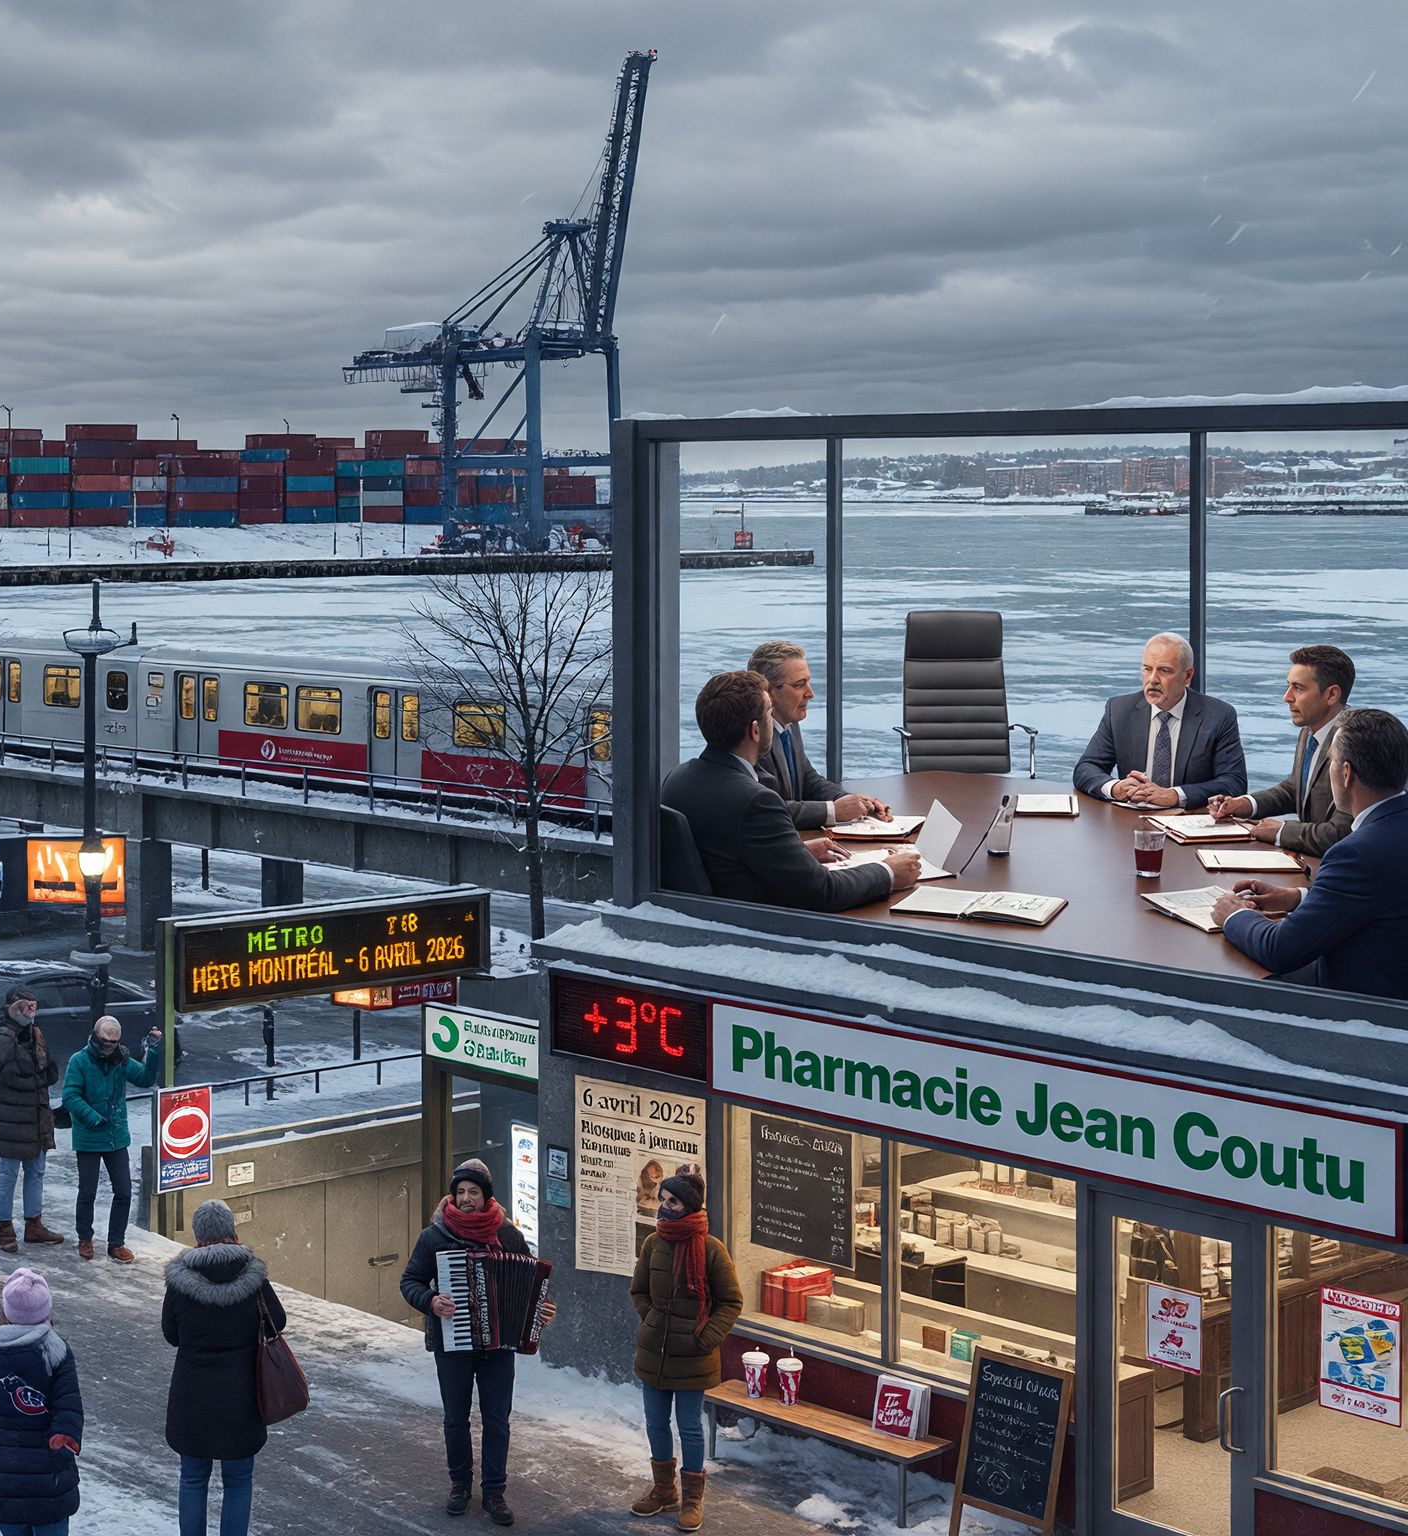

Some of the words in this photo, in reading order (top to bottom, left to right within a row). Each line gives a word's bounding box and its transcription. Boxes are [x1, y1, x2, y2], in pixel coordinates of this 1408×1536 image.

[248, 925, 324, 953] MÉTRO
[248, 947, 340, 987] MONTRÉAL
[359, 946, 369, 972] 6
[375, 941, 421, 971] AVRIL
[426, 935, 465, 963] 2026
[583, 1088, 593, 1107] 6
[649, 1100, 696, 1126] 2026
[731, 1024, 1002, 1126] Pharmacie
[1016, 1083, 1157, 1160] Jean
[1173, 1113, 1365, 1204] Coutu
